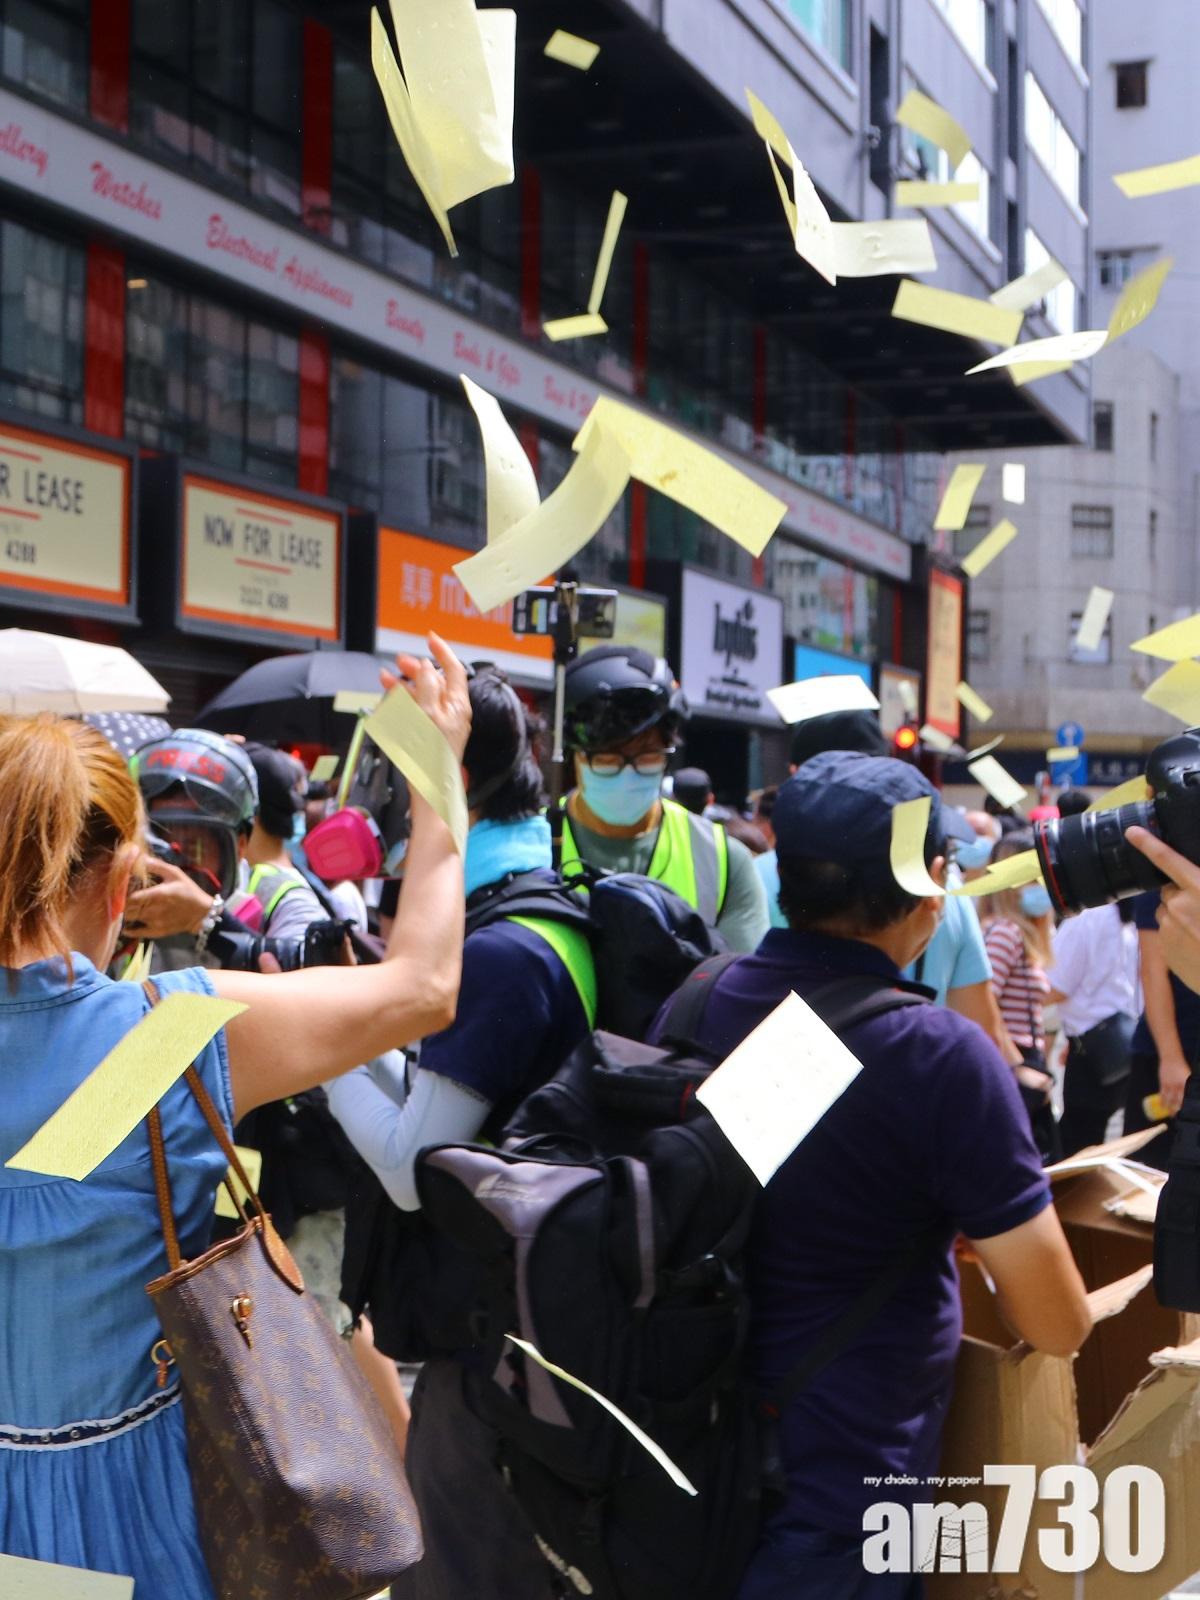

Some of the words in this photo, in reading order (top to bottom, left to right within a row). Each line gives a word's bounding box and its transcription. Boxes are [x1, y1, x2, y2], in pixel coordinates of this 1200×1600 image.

[89, 160, 162, 221] Watches
[24, 468, 84, 515] LEASE
[203, 514, 234, 549] NOW
[244, 521, 272, 558] FOR
[278, 530, 322, 570] LEASE
[146, 748, 226, 785] PRESS
